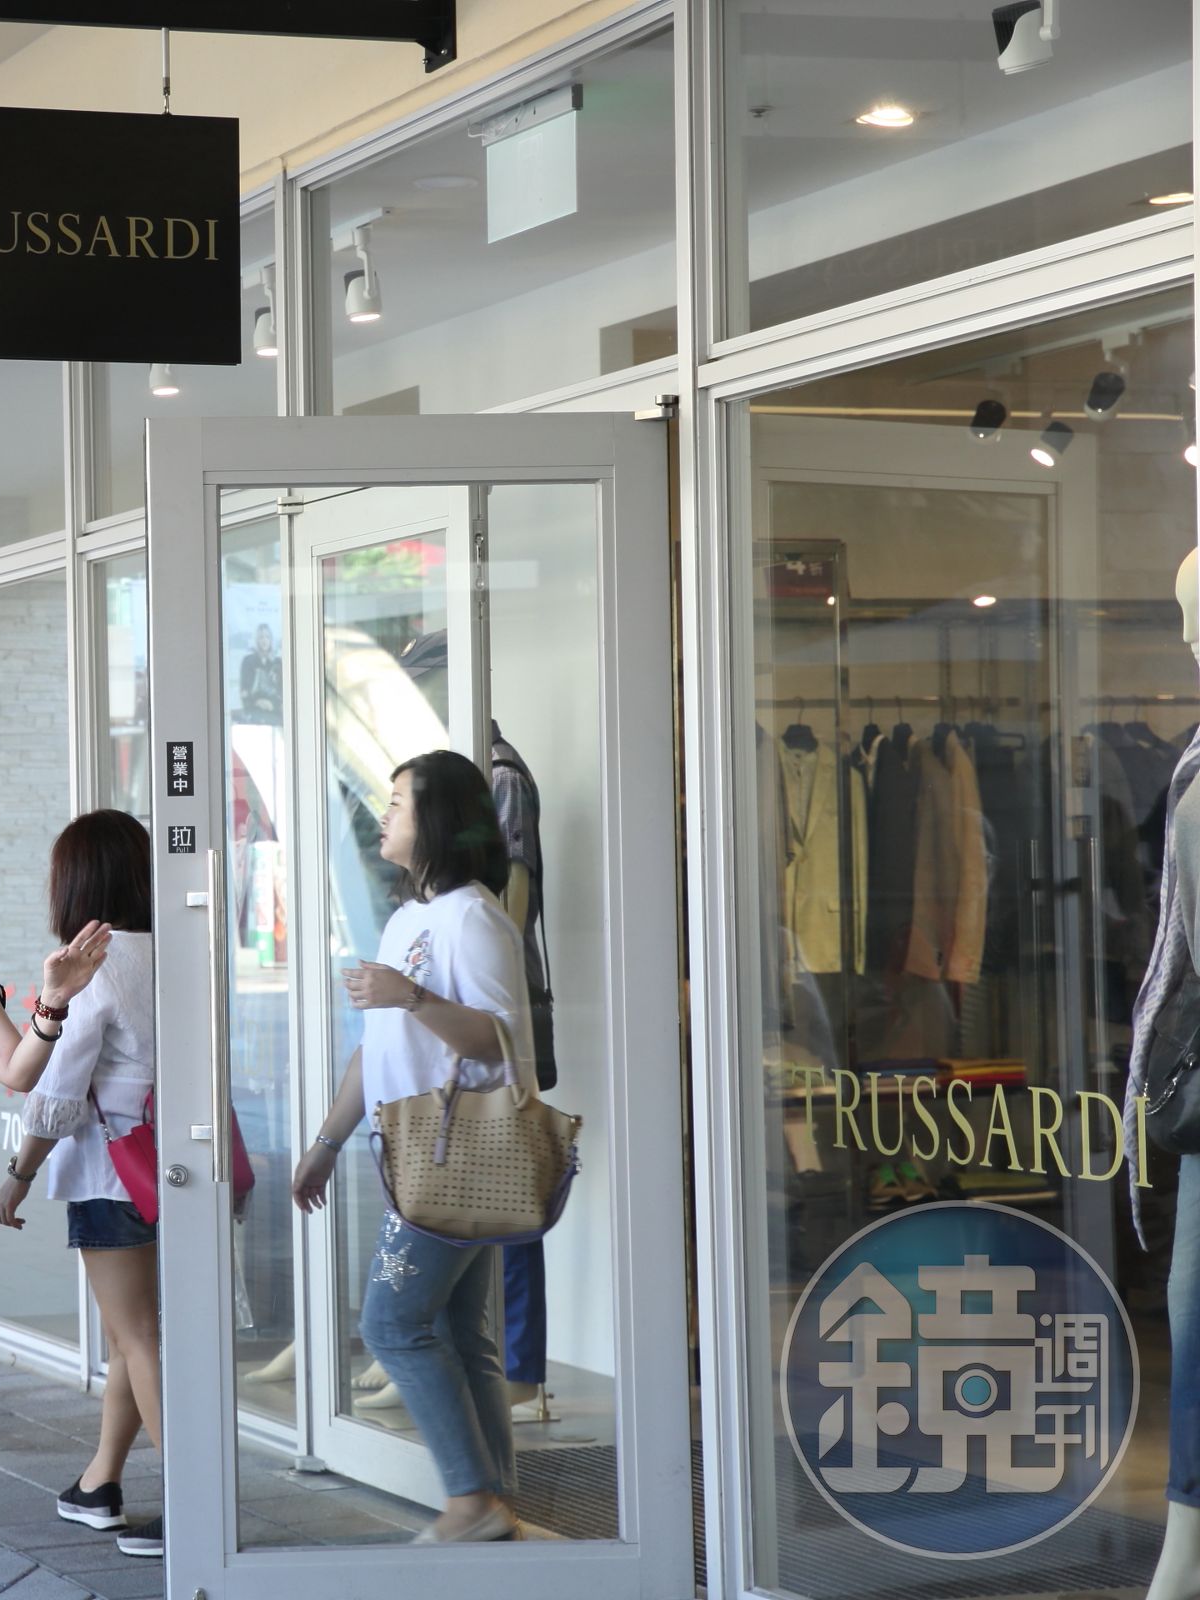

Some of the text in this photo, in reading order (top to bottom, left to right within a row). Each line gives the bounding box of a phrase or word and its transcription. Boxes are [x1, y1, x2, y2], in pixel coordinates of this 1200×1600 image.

[172, 745, 189, 793] 營業中
[172, 826, 192, 847] 拉
[0, 1111, 28, 1154] 70
[791, 1064, 1154, 1188] TRUSSARDI
